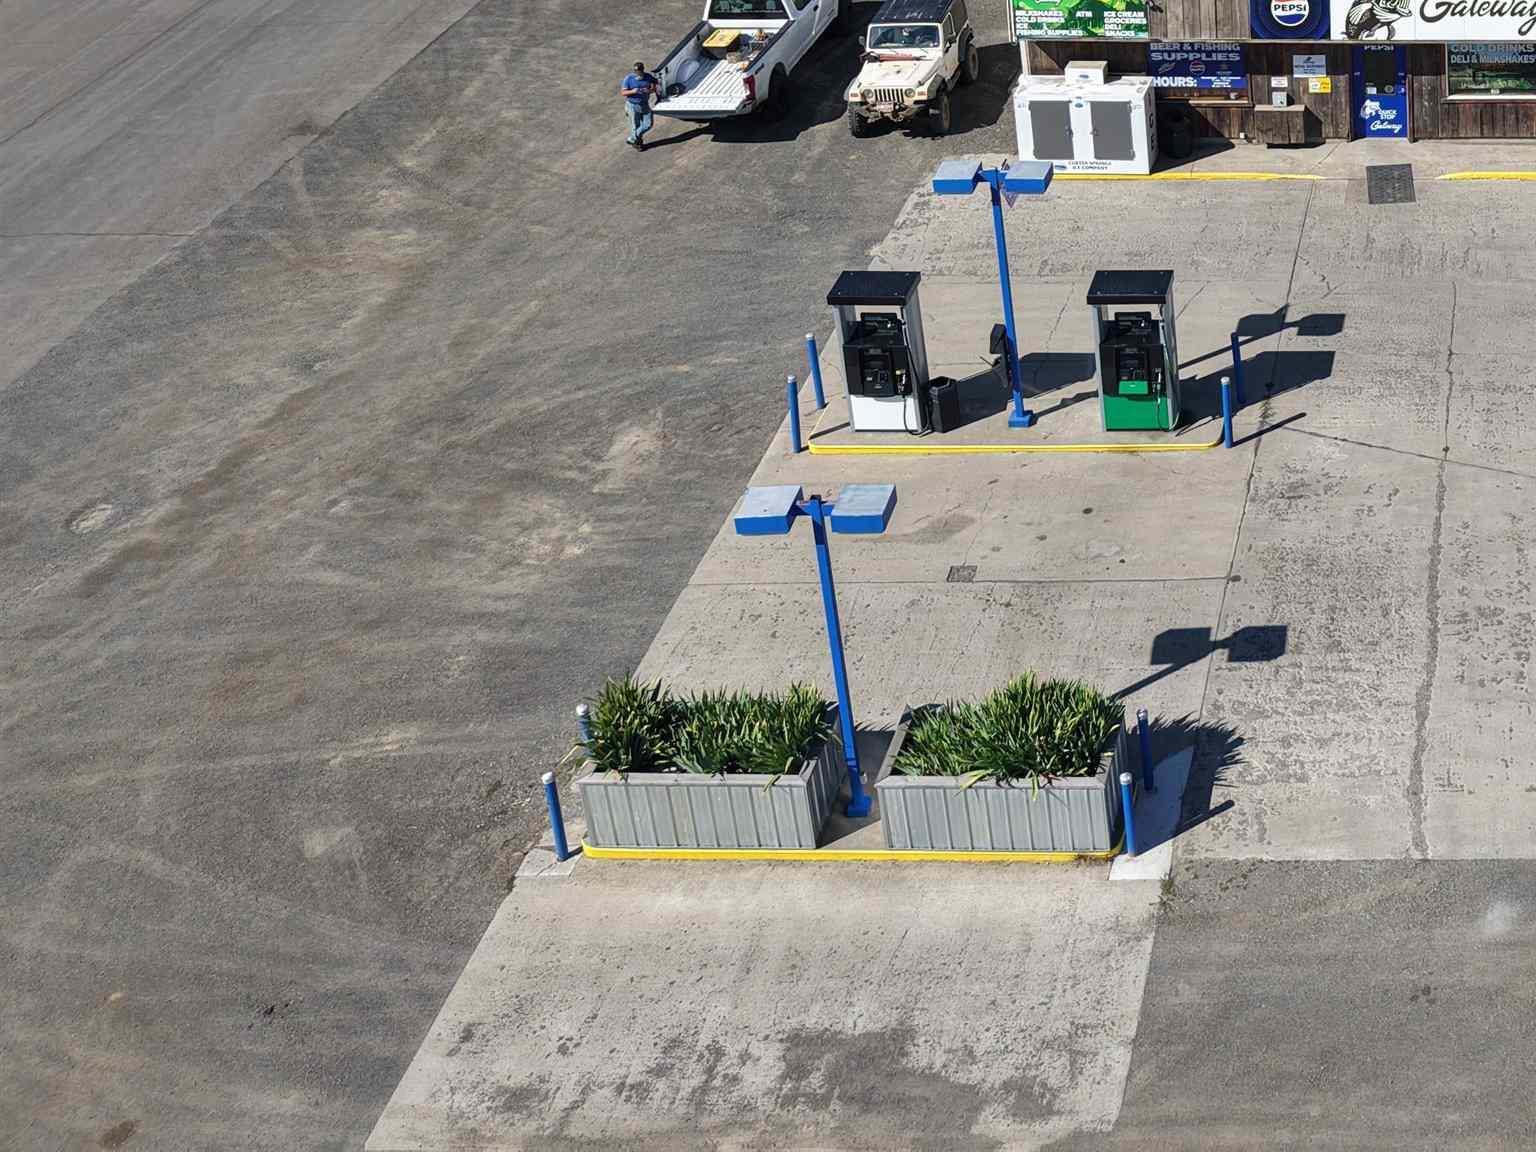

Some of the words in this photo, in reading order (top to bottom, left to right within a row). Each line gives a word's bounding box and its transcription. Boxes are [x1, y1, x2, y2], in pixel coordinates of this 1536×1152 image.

[1273, 4, 1307, 12] PEPSI
[1150, 43, 1180, 51] BEER
[1194, 43, 1240, 51] FISHING
[1451, 43, 1485, 52] COLD
[1488, 43, 1535, 52] DRINKS
[1151, 52, 1240, 61] SUPPLIES
[1451, 54, 1469, 64] DELI
[1153, 76, 1198, 87] HOURS:
